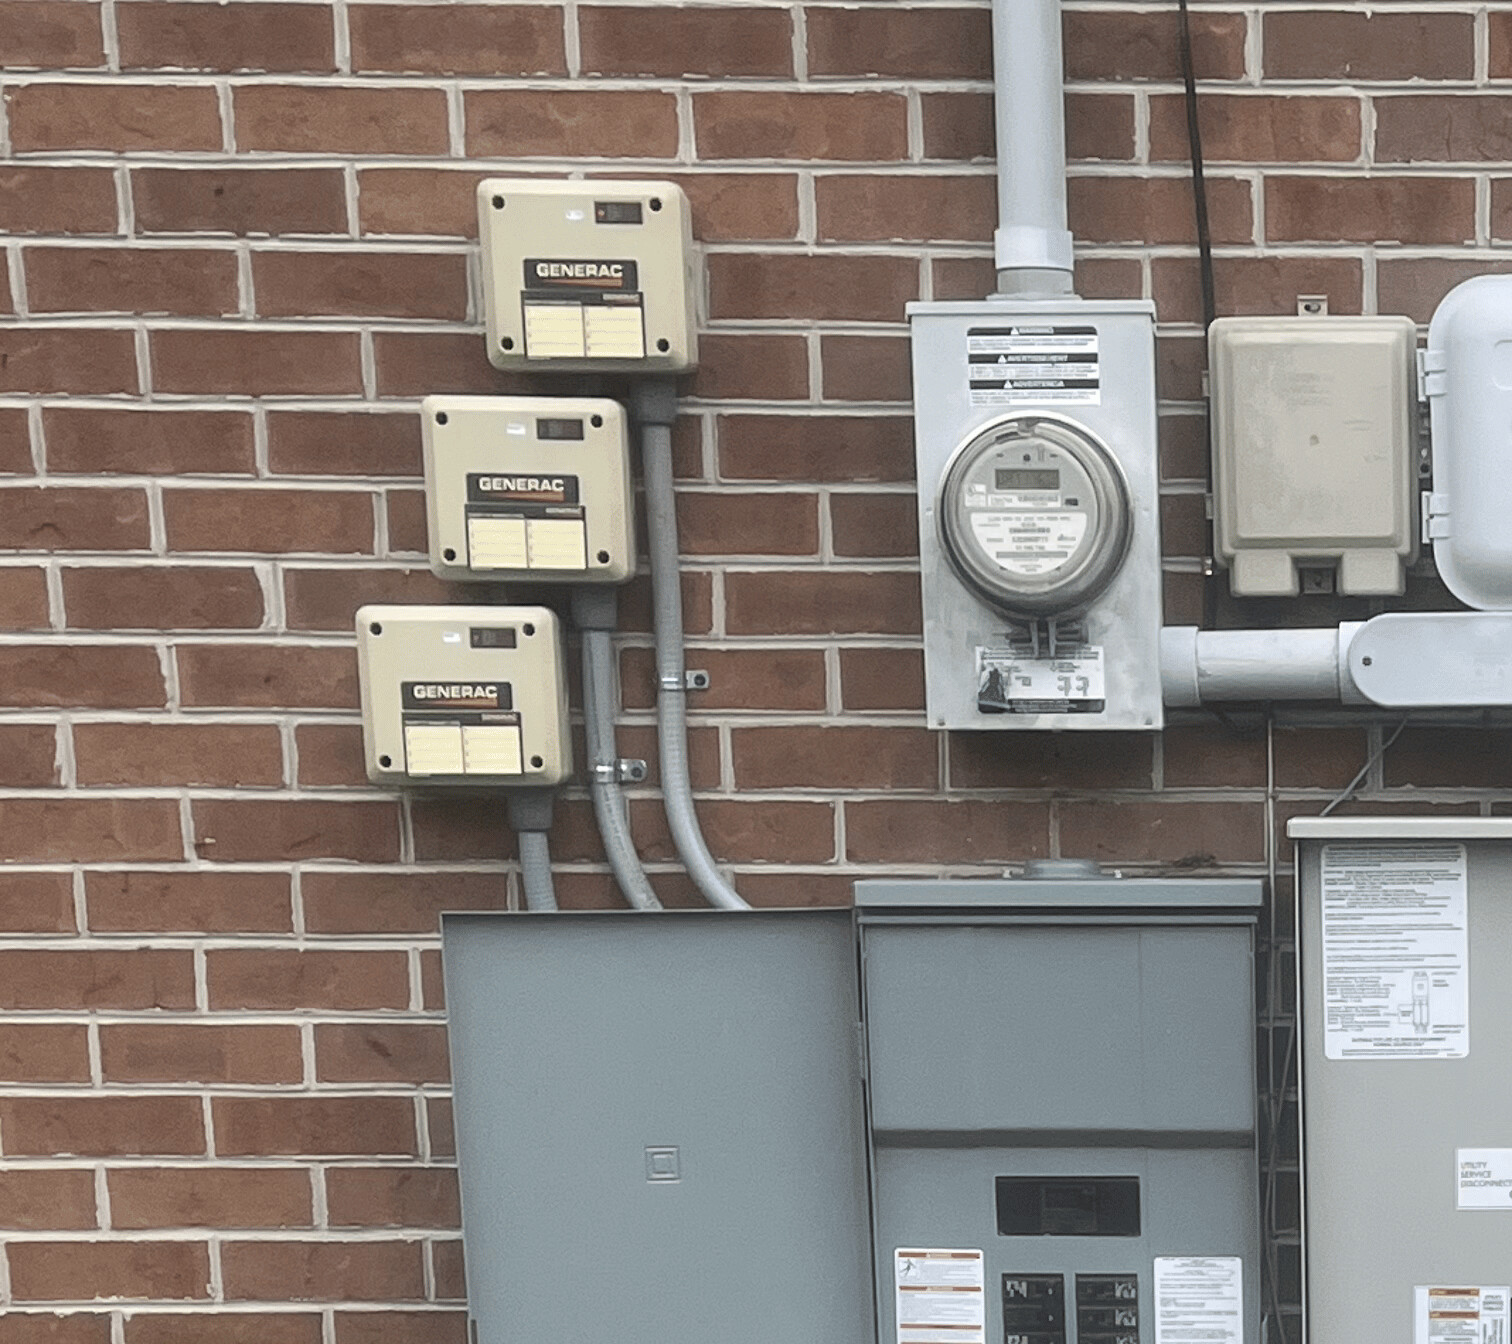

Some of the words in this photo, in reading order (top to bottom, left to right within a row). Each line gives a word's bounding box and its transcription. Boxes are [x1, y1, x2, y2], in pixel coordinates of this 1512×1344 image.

[536, 262, 623, 278] GENERAC
[478, 477, 565, 492] GENERAC
[412, 684, 499, 700] GENERAC
